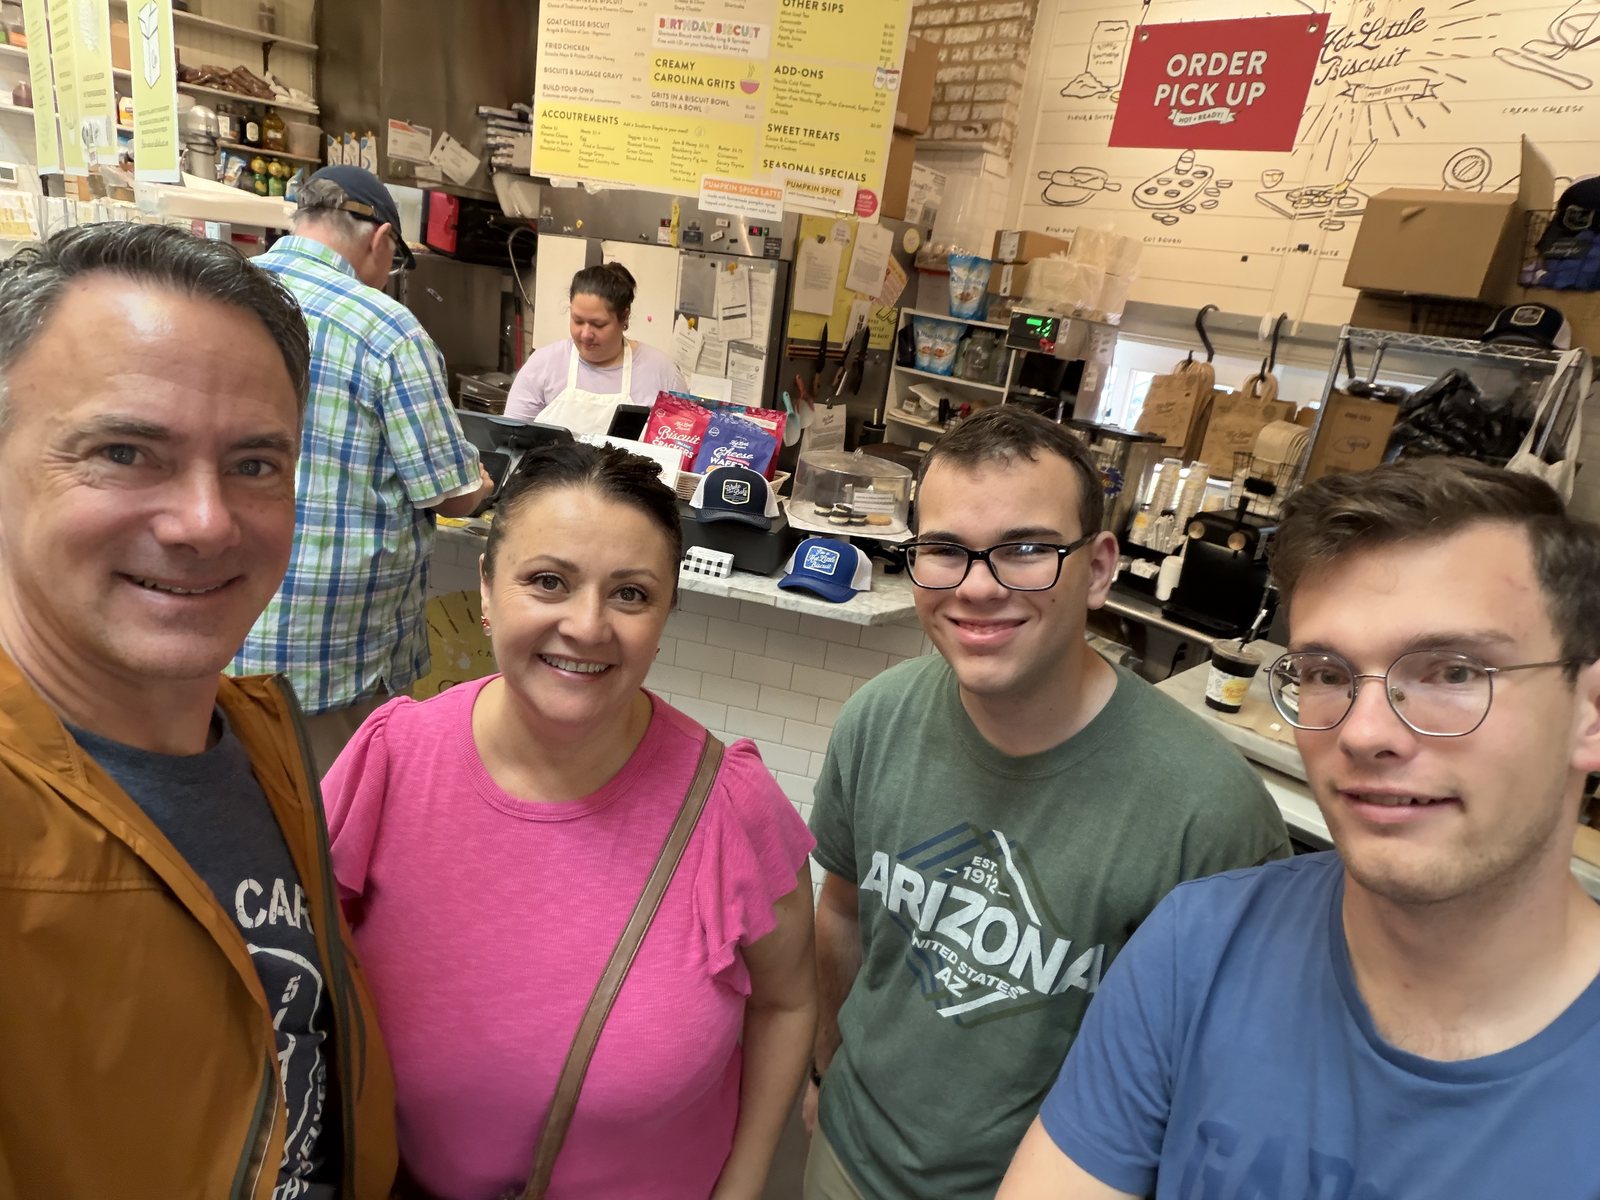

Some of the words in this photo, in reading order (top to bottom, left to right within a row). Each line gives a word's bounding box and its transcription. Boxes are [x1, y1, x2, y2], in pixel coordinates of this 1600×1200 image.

[782, 0, 818, 10] OTHER
[822, 2, 845, 13] SIPS
[563, 19, 586, 27] CHEESE
[587, 21, 610, 29] BISCUIT
[659, 18, 714, 34] BIRTHDAY
[716, 22, 761, 38] BISCUIT
[1355, 7, 1429, 50] Little
[545, 42, 562, 50] FRIED
[563, 43, 590, 52] CHICKEN
[544, 66, 568, 75] BISCUITS
[575, 69, 601, 78] SAUSAGE
[602, 71, 624, 80] GRAVY
[655, 58, 696, 71] CREAMY
[1166, 50, 1268, 78] ORDER
[1314, 47, 1411, 86] Biscuit
[543, 83, 560, 91] BUILD
[561, 85, 577, 93] YOUR
[578, 86, 594, 94] OWN
[654, 72, 704, 86] CAROLINA
[707, 77, 736, 90] GRITS
[651, 91, 670, 100] GRITS
[670, 93, 678, 101] IN
[684, 95, 710, 105] BISCUIT
[711, 98, 730, 107] BOWL
[1153, 82, 1221, 107] PICK
[1225, 81, 1267, 106] UP
[651, 100, 669, 109] GRITS
[684, 103, 702, 113] BOWL
[1542, 105, 1584, 114] CHEESE
[541, 109, 619, 125] ACCOUTREMENTS
[767, 123, 801, 136] SWEET
[803, 128, 840, 142] TREATS
[763, 159, 816, 175] SEASONAL
[819, 167, 867, 183] SPECIALS
[704, 179, 737, 192] PUMPKIN
[739, 185, 760, 195] SPICE
[761, 188, 782, 199] LATTE
[786, 180, 820, 193] PUMPKIN
[820, 186, 842, 197] SPICE
[656, 425, 701, 445] Biscuit
[713, 447, 754, 460] Cheese
[710, 456, 749, 470] WAFE
[971, 856, 998, 874] EST.
[962, 866, 999, 894] 1912
[860, 850, 1105, 995] ARIZONA
[912, 929, 960, 965] NITED
[956, 962, 1020, 1000] STATES
[934, 967, 968, 998] AZ
